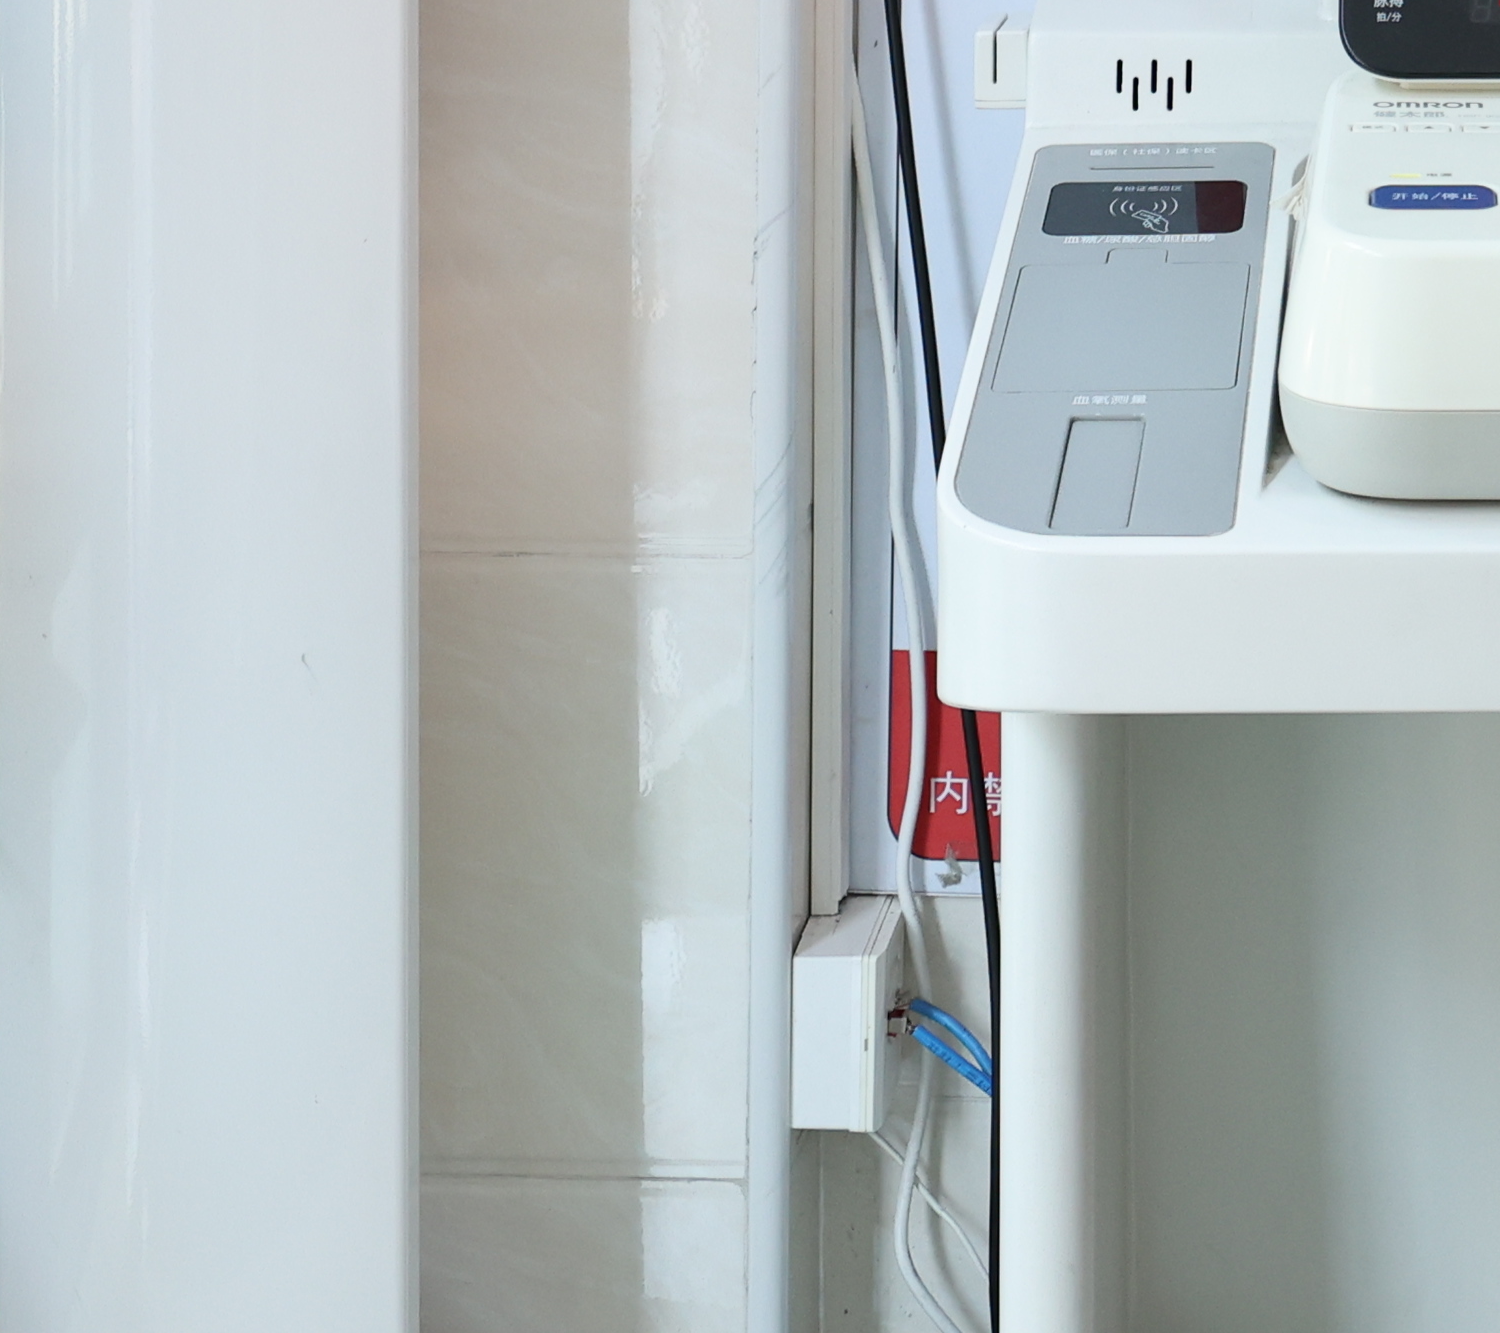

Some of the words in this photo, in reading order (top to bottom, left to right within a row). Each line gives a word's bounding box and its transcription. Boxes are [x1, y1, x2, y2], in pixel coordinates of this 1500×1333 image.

[1376, 10, 1402, 23] 拍/分
[1373, 101, 1484, 109] OMRON
[1391, 192, 1479, 201] 开始/停止
[1071, 393, 1149, 406] 血氧测量
